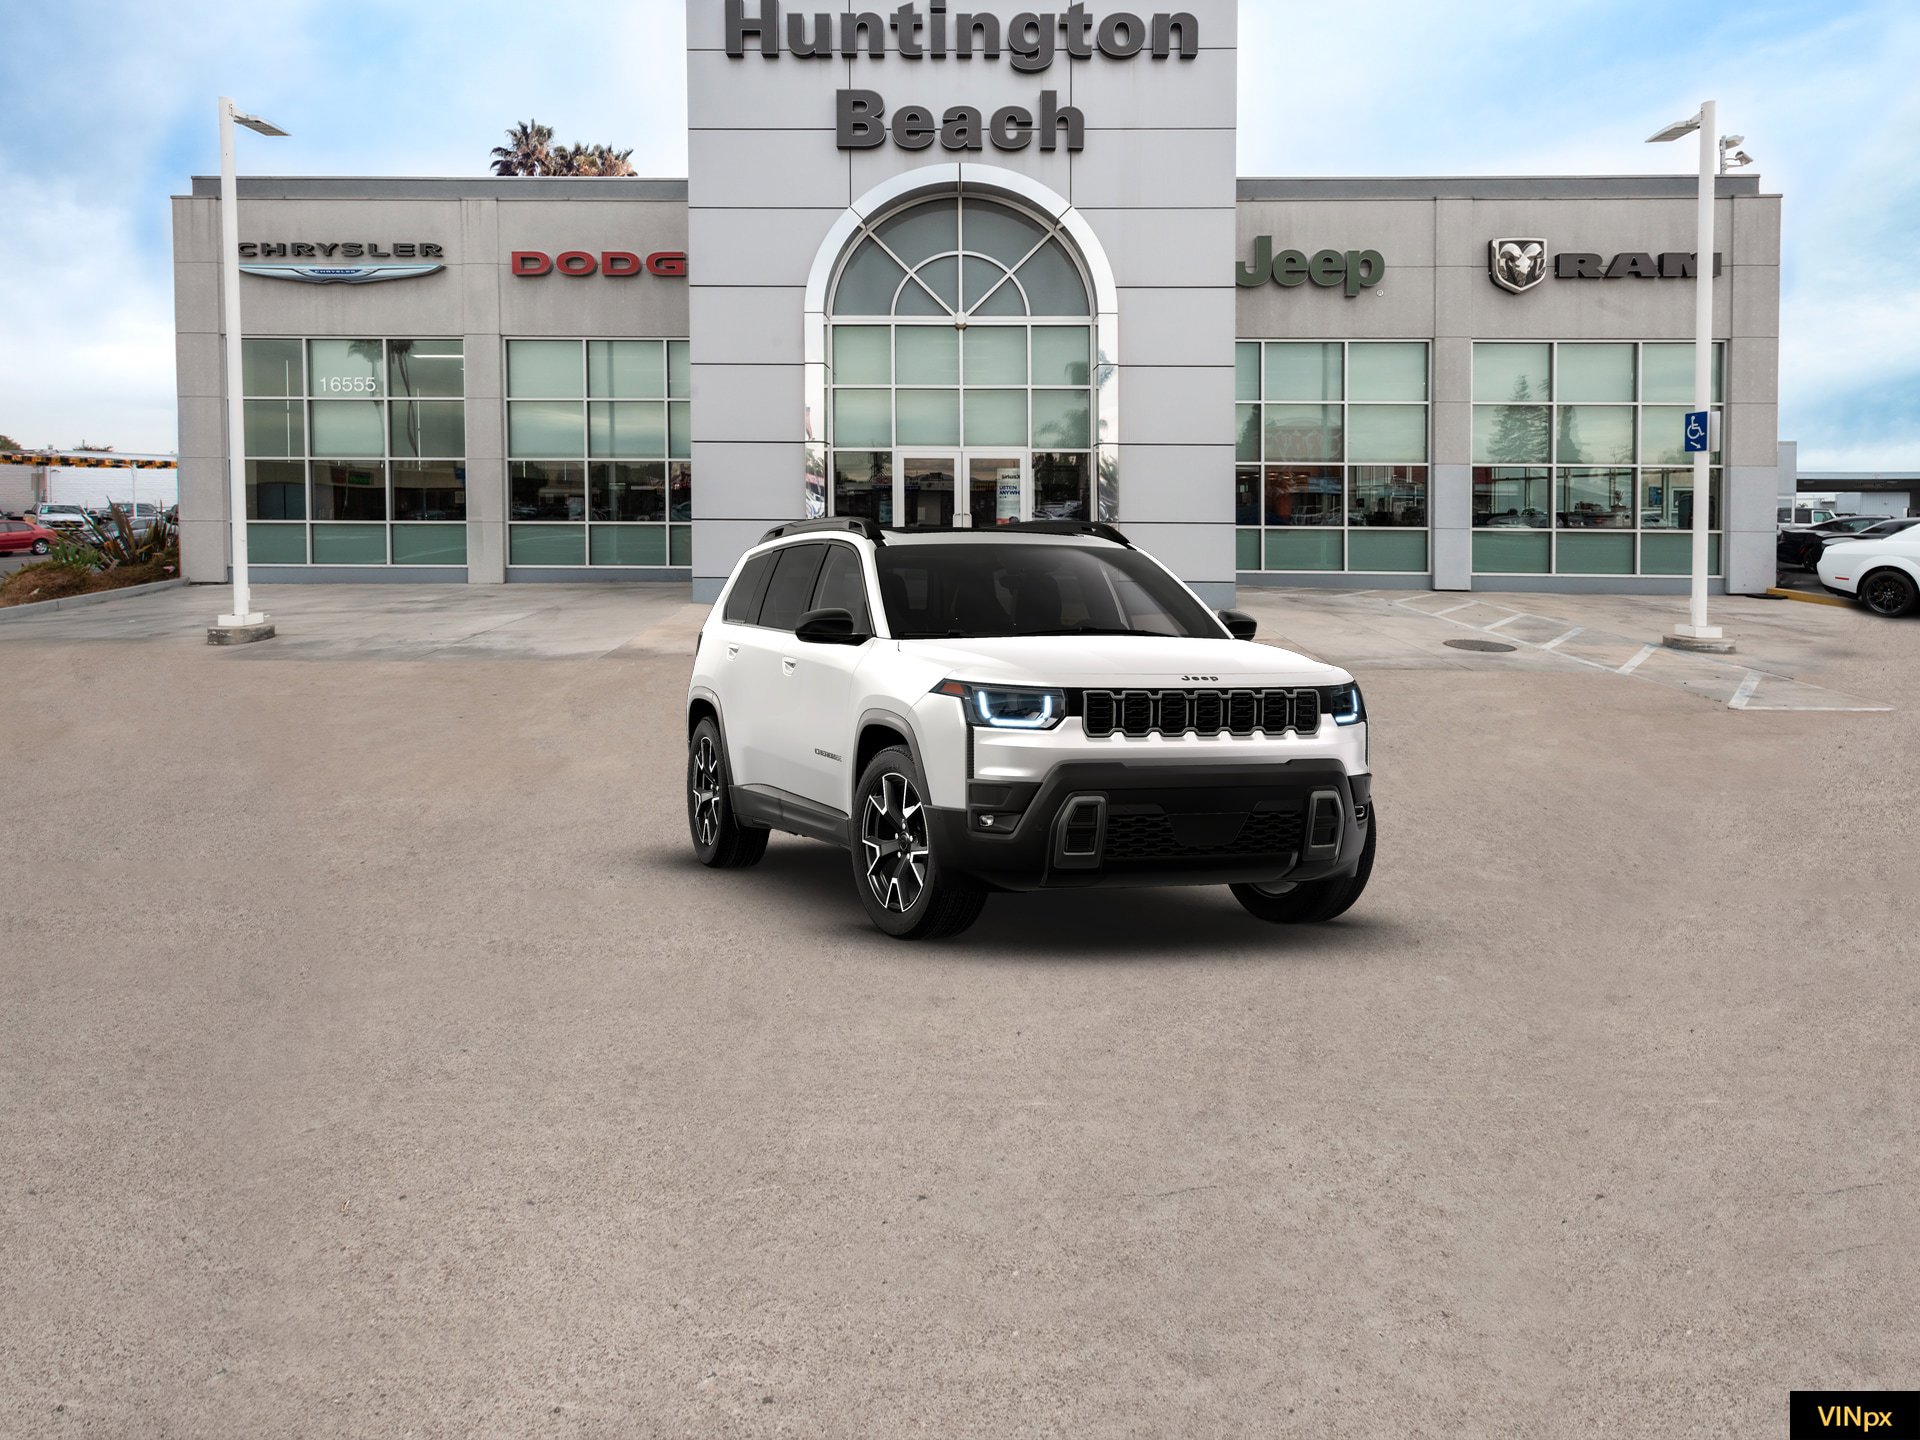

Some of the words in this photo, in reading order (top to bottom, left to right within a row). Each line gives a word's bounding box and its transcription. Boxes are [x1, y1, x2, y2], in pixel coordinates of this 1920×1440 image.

[724, 0, 1200, 73] Huntington
[835, 88, 1085, 152] Beach
[238, 241, 445, 258] CHRYSLER
[1235, 235, 1386, 298] Jeep
[1554, 252, 1722, 279] RAM
[319, 376, 376, 392] 16555
